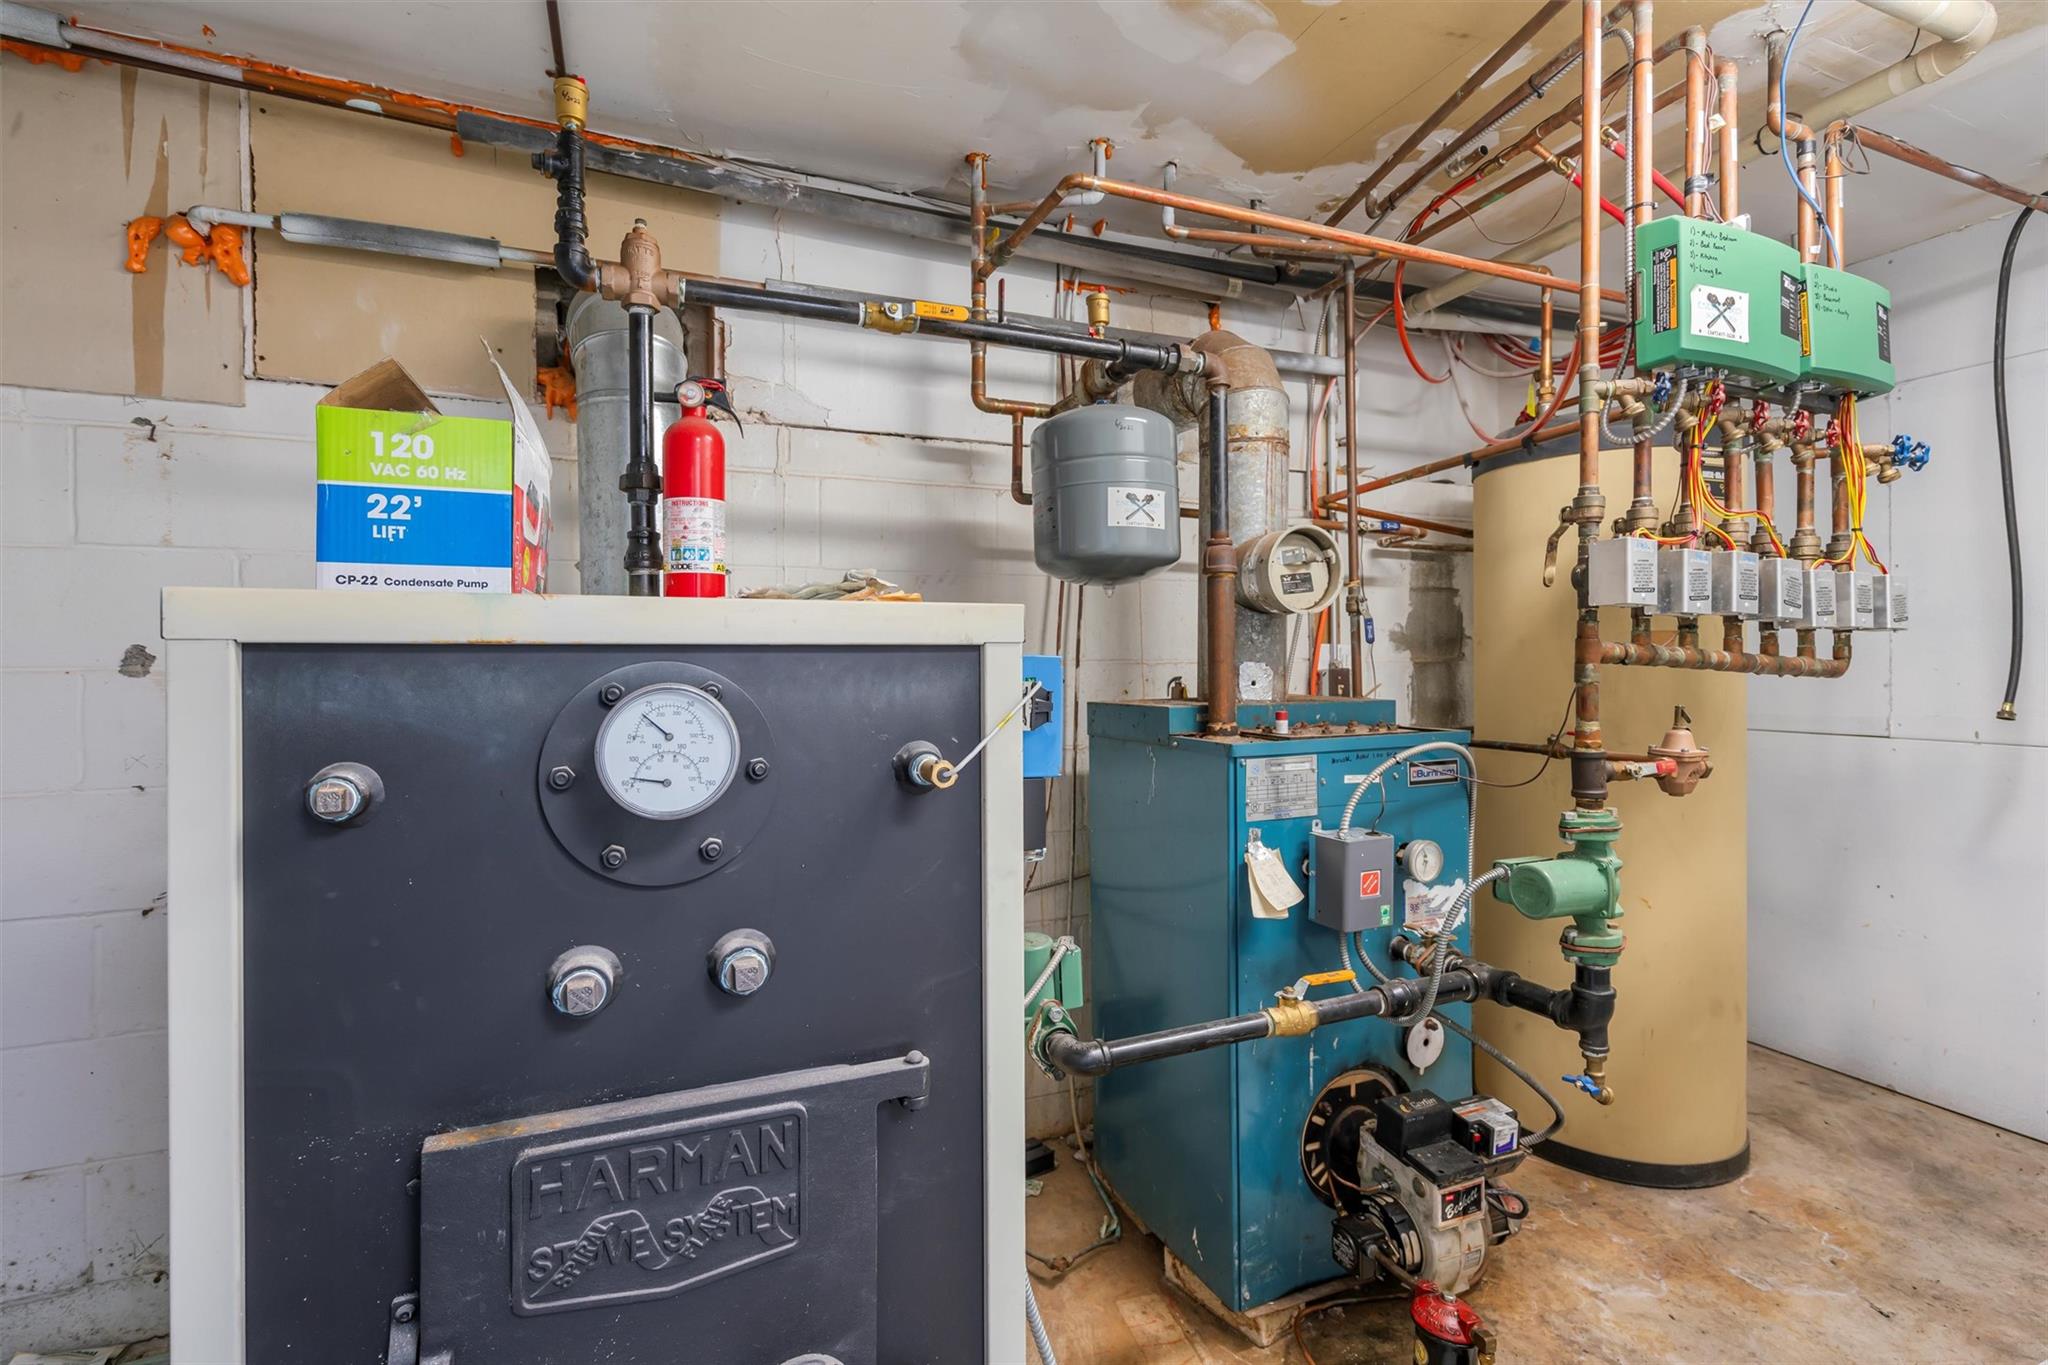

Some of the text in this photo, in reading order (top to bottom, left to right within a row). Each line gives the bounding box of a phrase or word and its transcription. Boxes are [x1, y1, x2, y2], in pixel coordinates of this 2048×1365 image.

[370, 430, 434, 460] 120
[370, 462, 467, 481] VAC 60 Hz
[372, 524, 407, 540] LIFT
[335, 573, 489, 590] CP-22 Condensate Pump
[529, 1121, 793, 1220] HARMAN
[551, 1219, 615, 1289] SPIRAL
